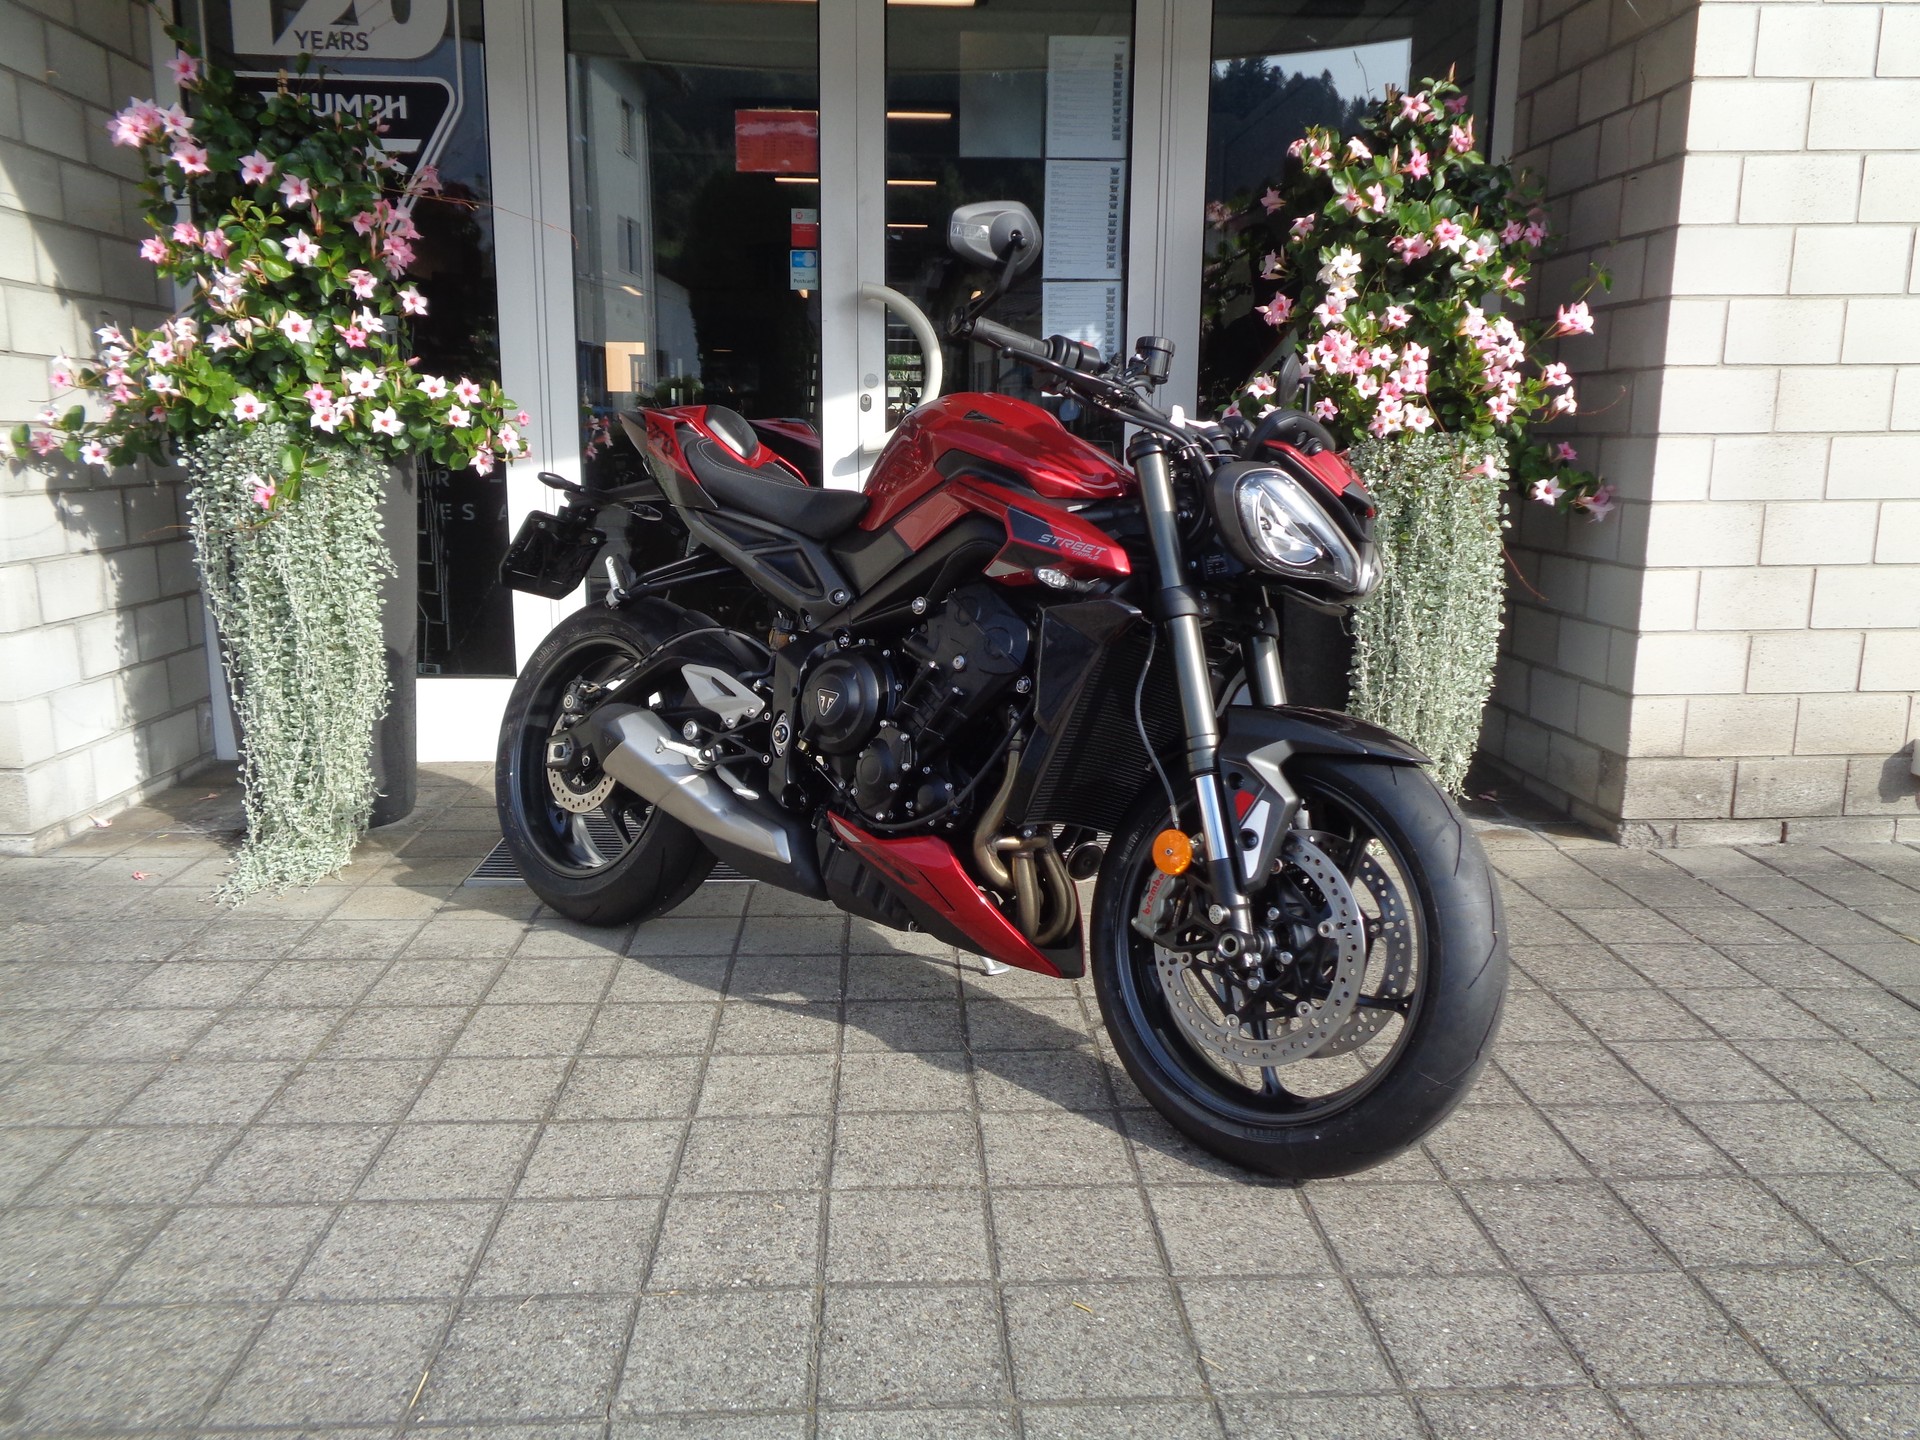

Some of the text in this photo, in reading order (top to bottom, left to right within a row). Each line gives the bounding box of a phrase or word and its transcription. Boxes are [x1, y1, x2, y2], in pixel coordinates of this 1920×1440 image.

[293, 30, 369, 50] YEARS
[258, 91, 408, 120] UMPH
[1038, 533, 1108, 555] STREET
[1072, 550, 1100, 560] TRIPLE
[1141, 873, 1165, 915] brembo
